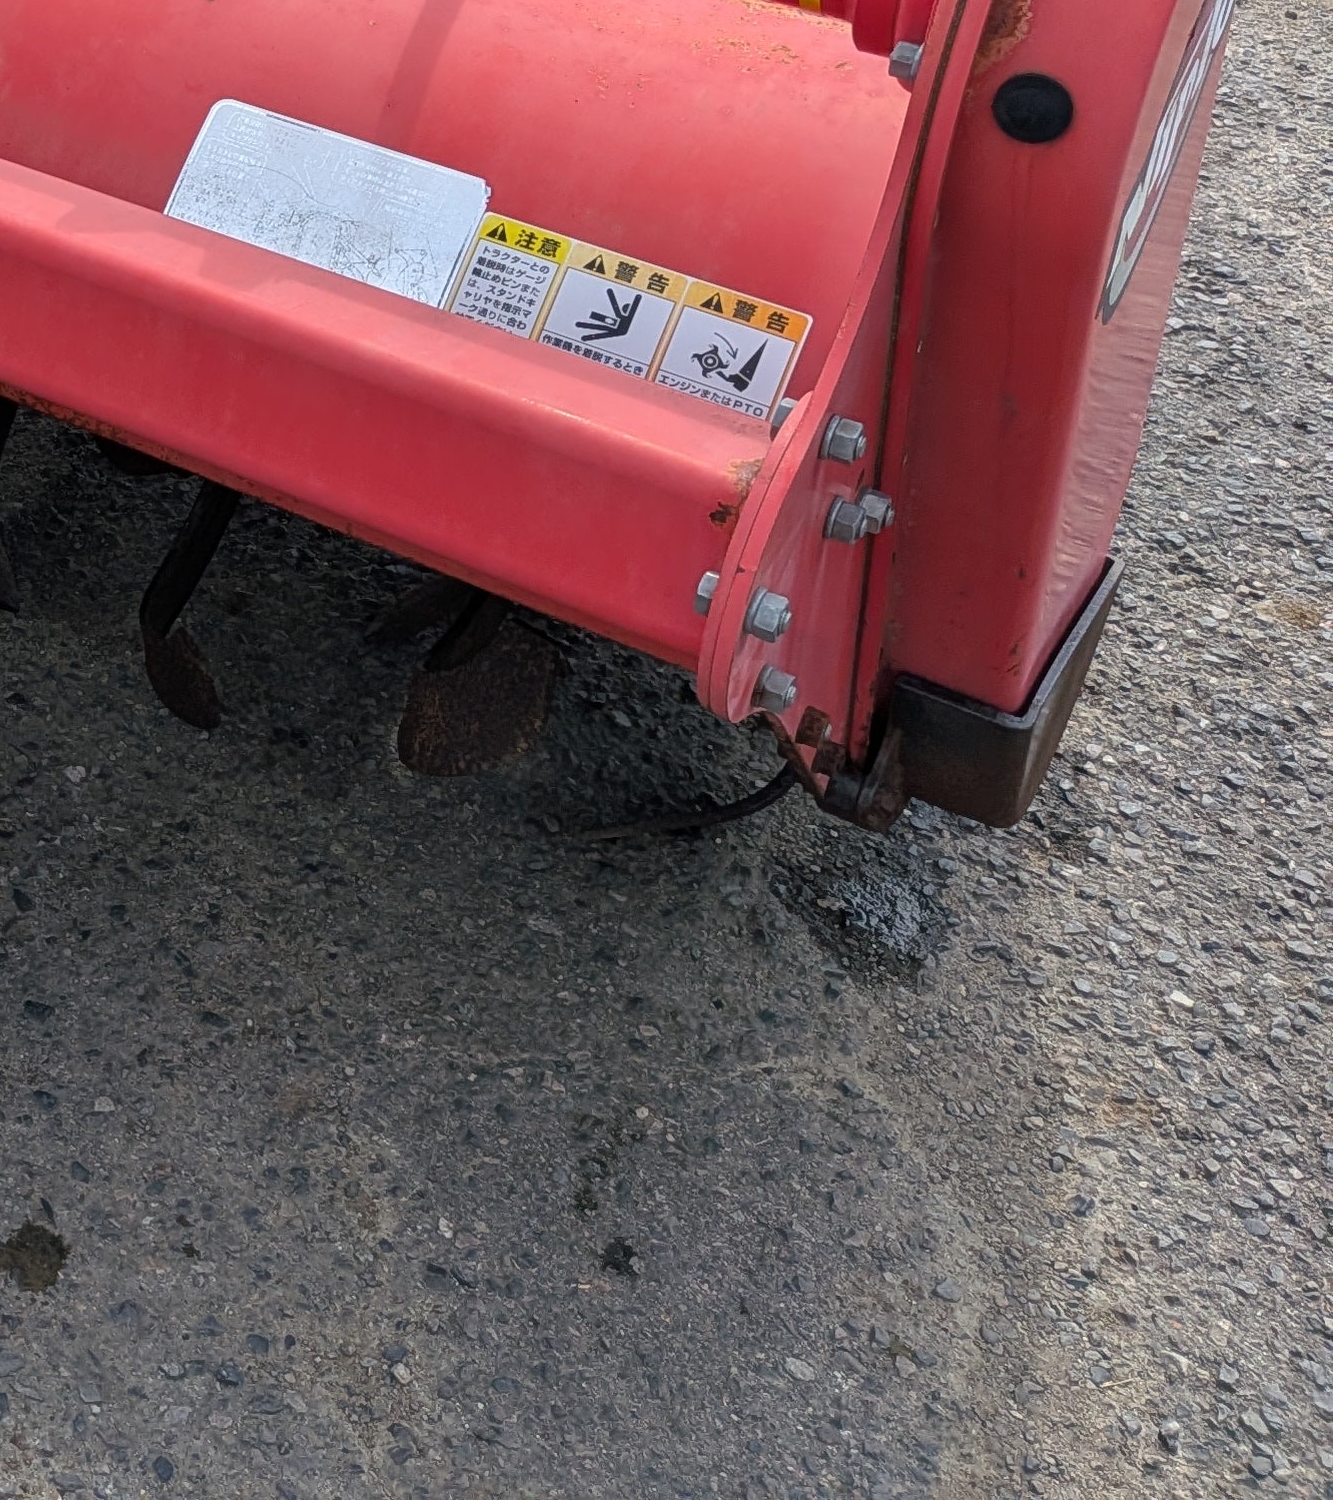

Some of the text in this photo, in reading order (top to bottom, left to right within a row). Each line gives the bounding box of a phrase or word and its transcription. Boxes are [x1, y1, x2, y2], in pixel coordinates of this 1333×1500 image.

[482, 245, 550, 275] トラクターとの
[514, 228, 562, 259] 注意
[614, 260, 671, 295] 警告
[732, 298, 790, 334] 警告
[542, 333, 644, 377] 作業機を着脱するとき
[657, 373, 764, 418] エンジンまたはPTO
